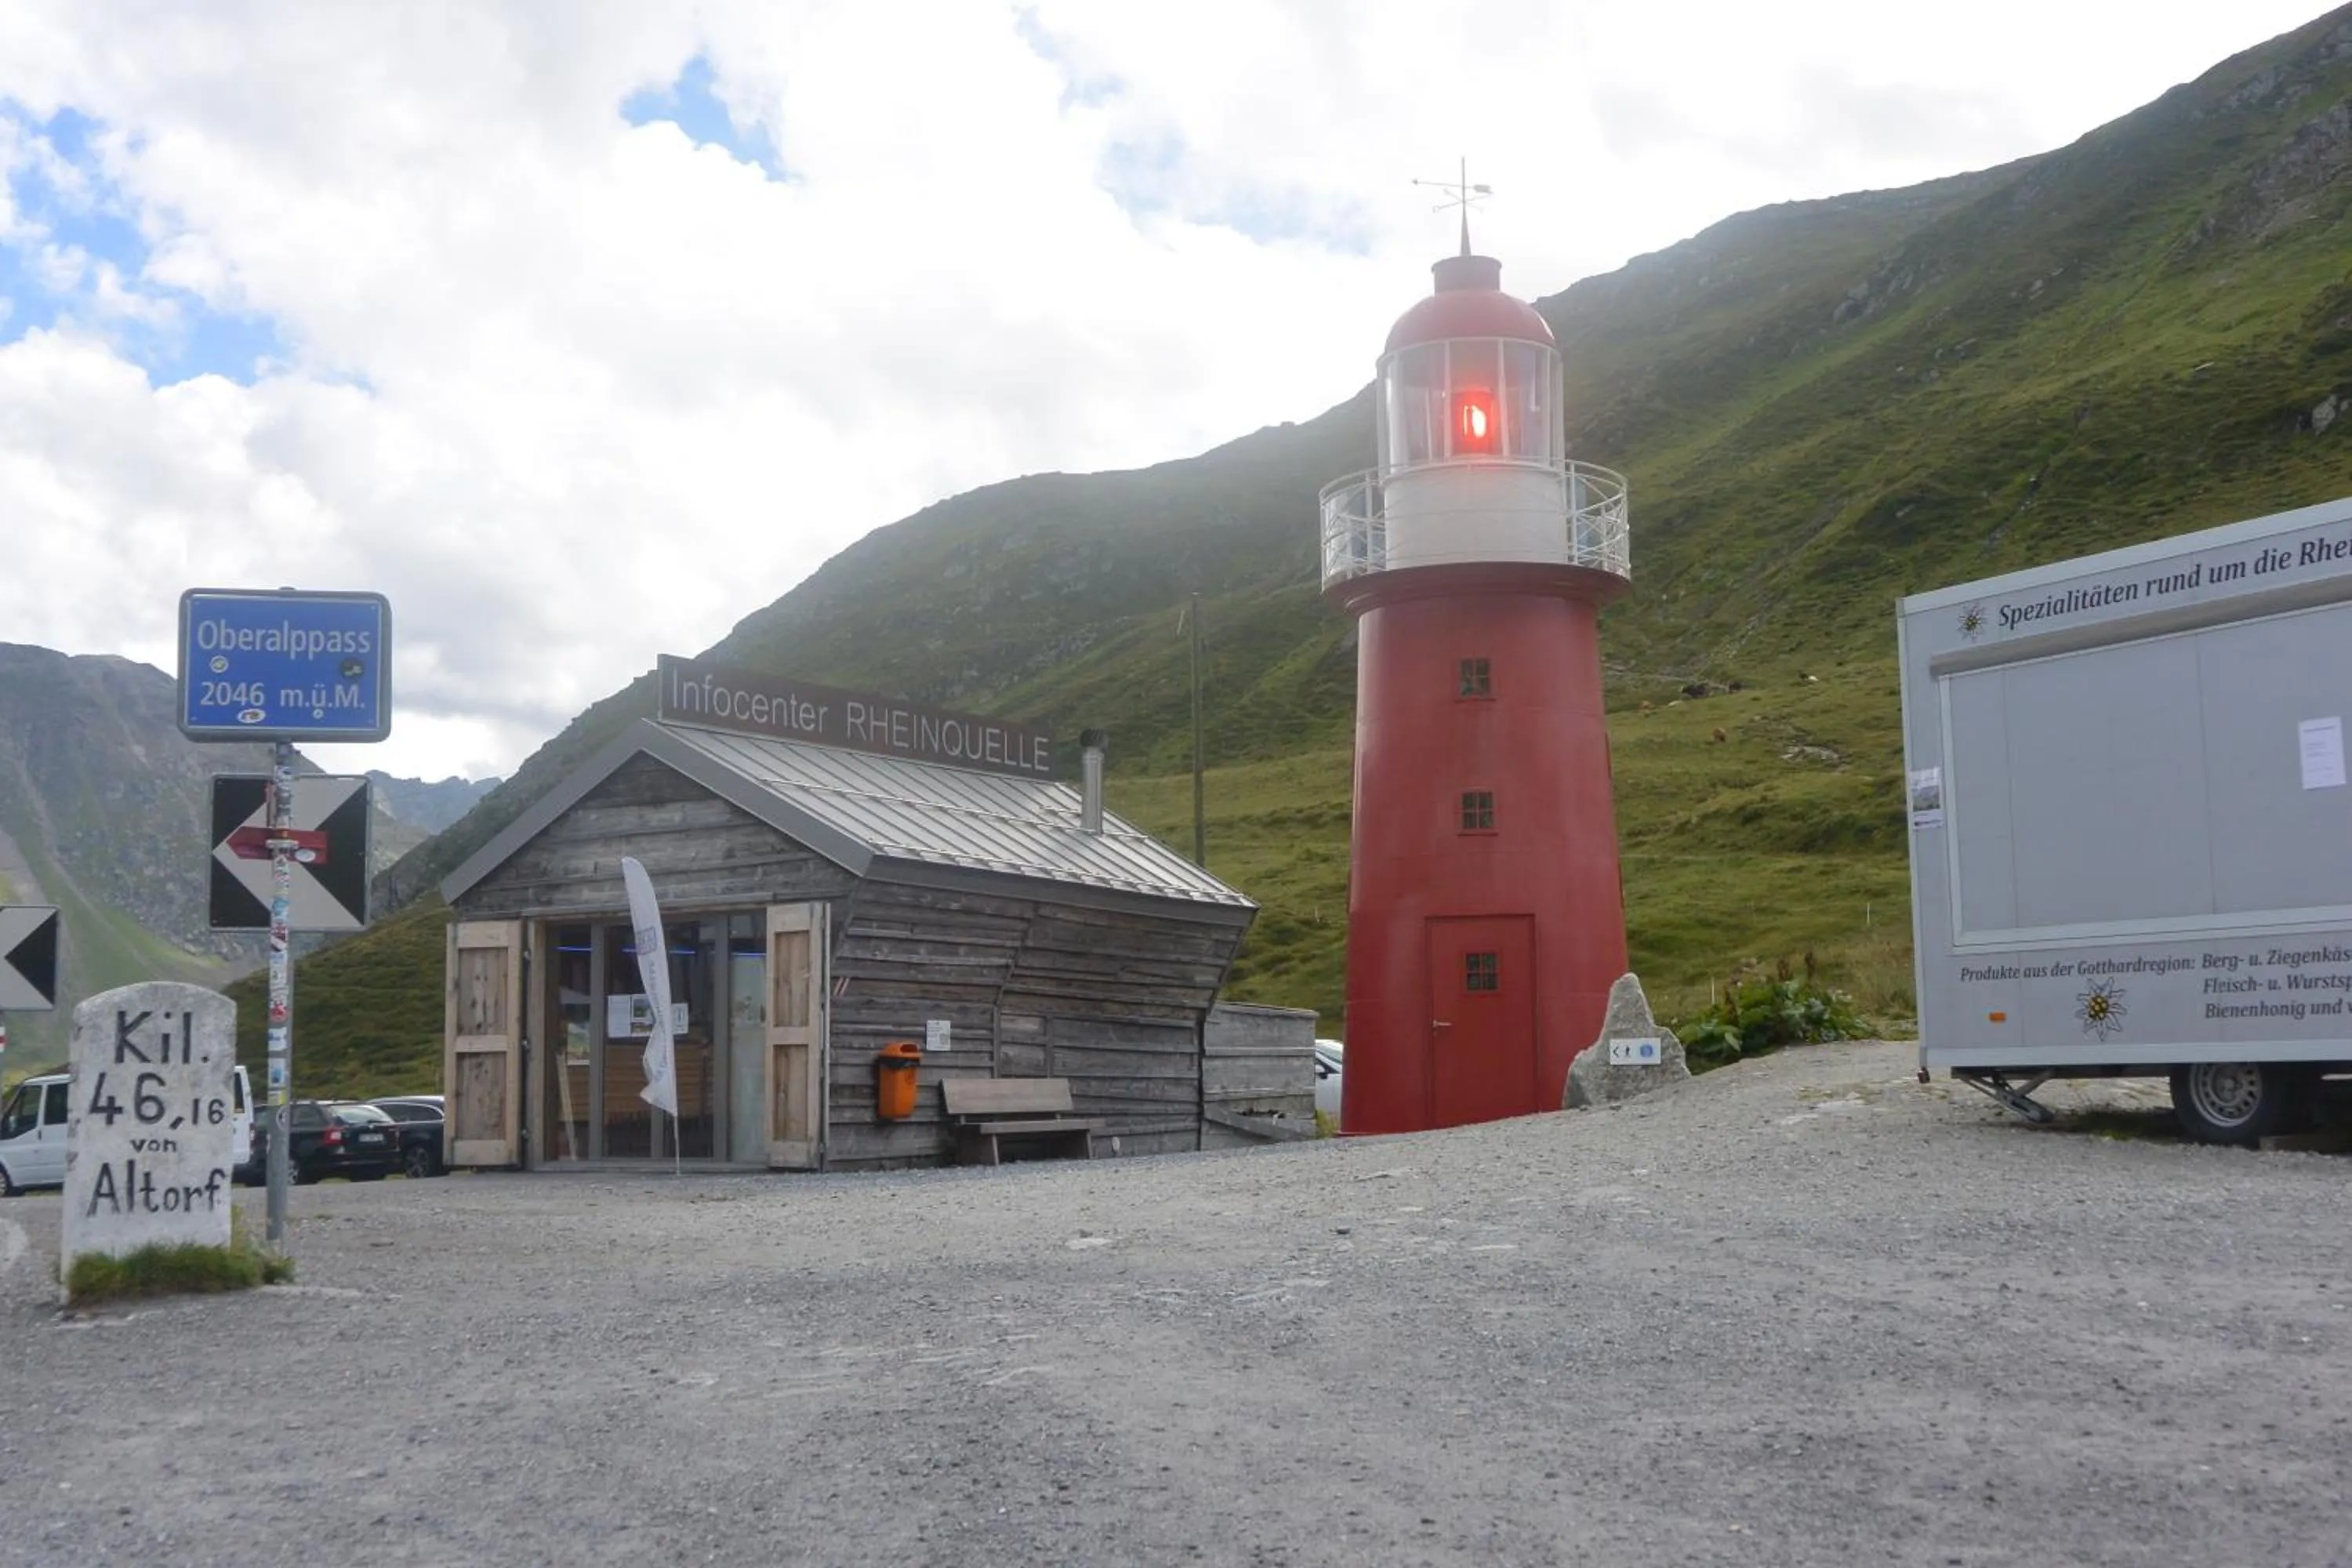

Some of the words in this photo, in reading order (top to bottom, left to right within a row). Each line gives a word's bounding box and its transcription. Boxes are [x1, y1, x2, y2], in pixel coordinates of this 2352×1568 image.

[1998, 582, 2139, 630] Spezialitäten
[2146, 564, 2201, 597] rund
[2209, 560, 2246, 584] um
[2254, 548, 2292, 575] die
[197, 619, 371, 661] Oberalppass
[199, 681, 265, 706] 2046
[280, 684, 365, 710] m.ü.M.
[672, 666, 829, 734] Infocenter
[846, 701, 1051, 771] RHEINQUELLE
[1960, 965, 2020, 982] Produkte
[2024, 966, 2049, 979] aus
[2050, 961, 2074, 978] der
[2077, 955, 2195, 976] Gotthardregion:
[2201, 953, 2245, 972] Berg-
[2249, 953, 2263, 967] u.
[2203, 975, 2263, 994] Fleisch-
[2267, 978, 2282, 991] u.
[2205, 999, 2307, 1021] Bienenhonig
[2310, 997, 2343, 1015] und
[114, 1010, 211, 1065] Kil.
[88, 1071, 226, 1130] 46,16
[130, 1138, 178, 1153] von
[86, 1158, 226, 1218] Altorf
